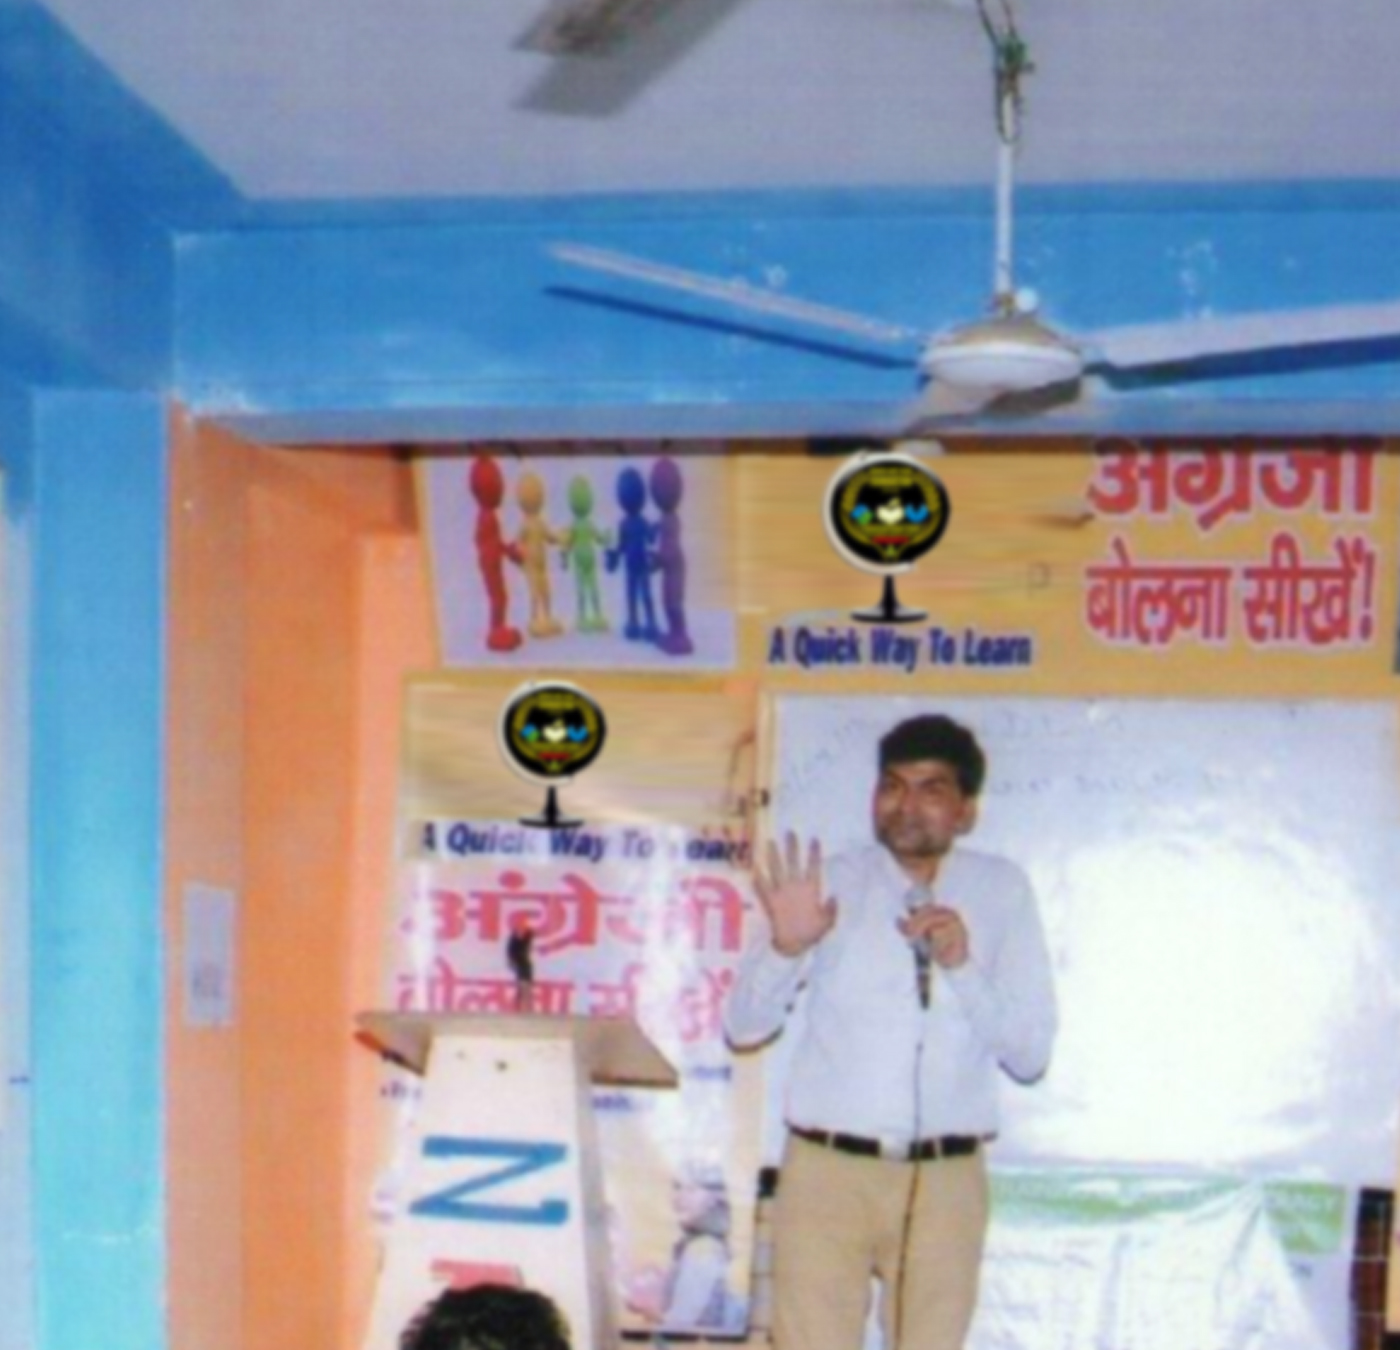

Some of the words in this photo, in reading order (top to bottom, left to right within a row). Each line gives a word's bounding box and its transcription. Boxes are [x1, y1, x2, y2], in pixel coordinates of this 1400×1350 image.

[1086, 537, 1232, 644] बोलना
[768, 626, 786, 664] A
[794, 626, 861, 668] Quick
[871, 627, 920, 673] Way
[930, 627, 956, 665] To
[964, 628, 1032, 666] Learn
[550, 822, 602, 862] Way
